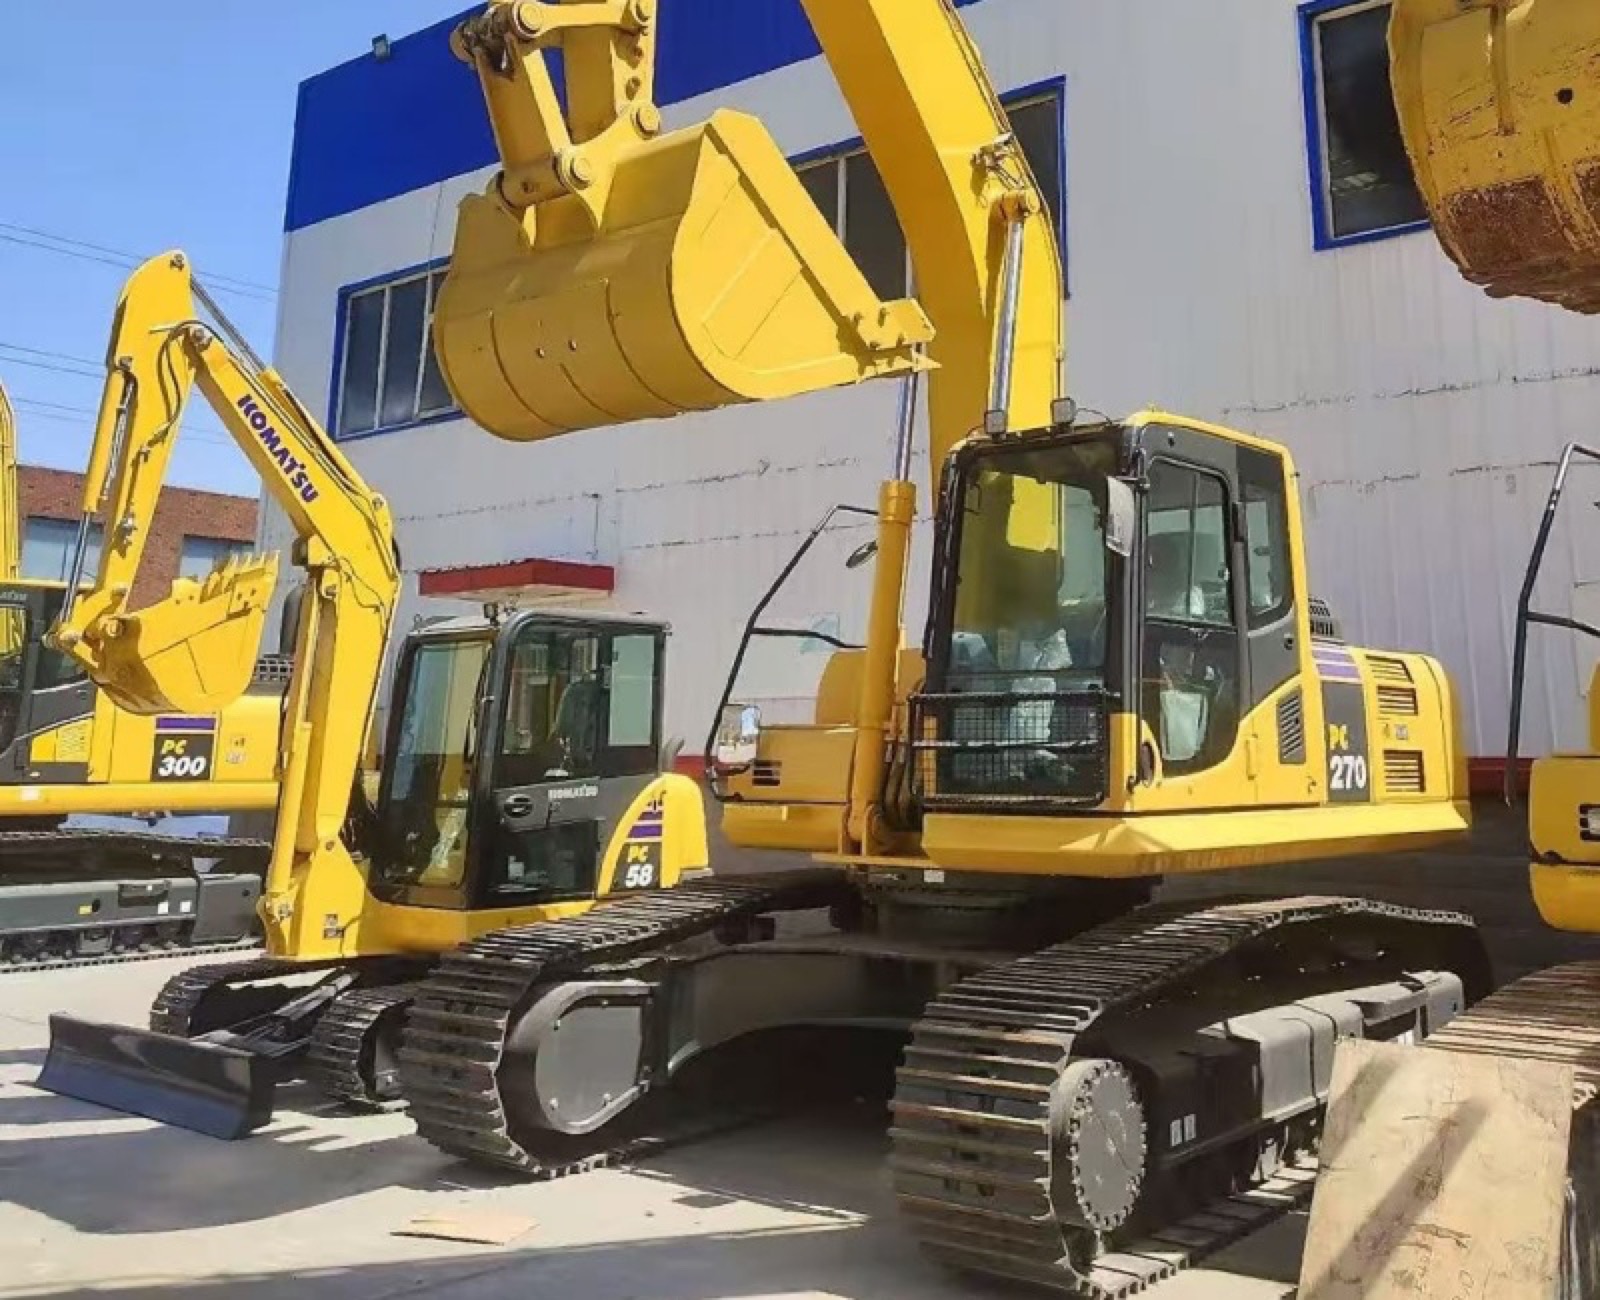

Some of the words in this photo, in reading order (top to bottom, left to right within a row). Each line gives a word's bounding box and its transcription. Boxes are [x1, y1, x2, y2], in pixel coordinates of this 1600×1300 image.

[237, 393, 319, 502] KOMATSU
[160, 739, 187, 755] PC
[1329, 723, 1349, 750] PC
[158, 756, 207, 777] 300
[1329, 755, 1367, 789] 270
[627, 845, 649, 863] PC
[625, 863, 653, 888] 58
